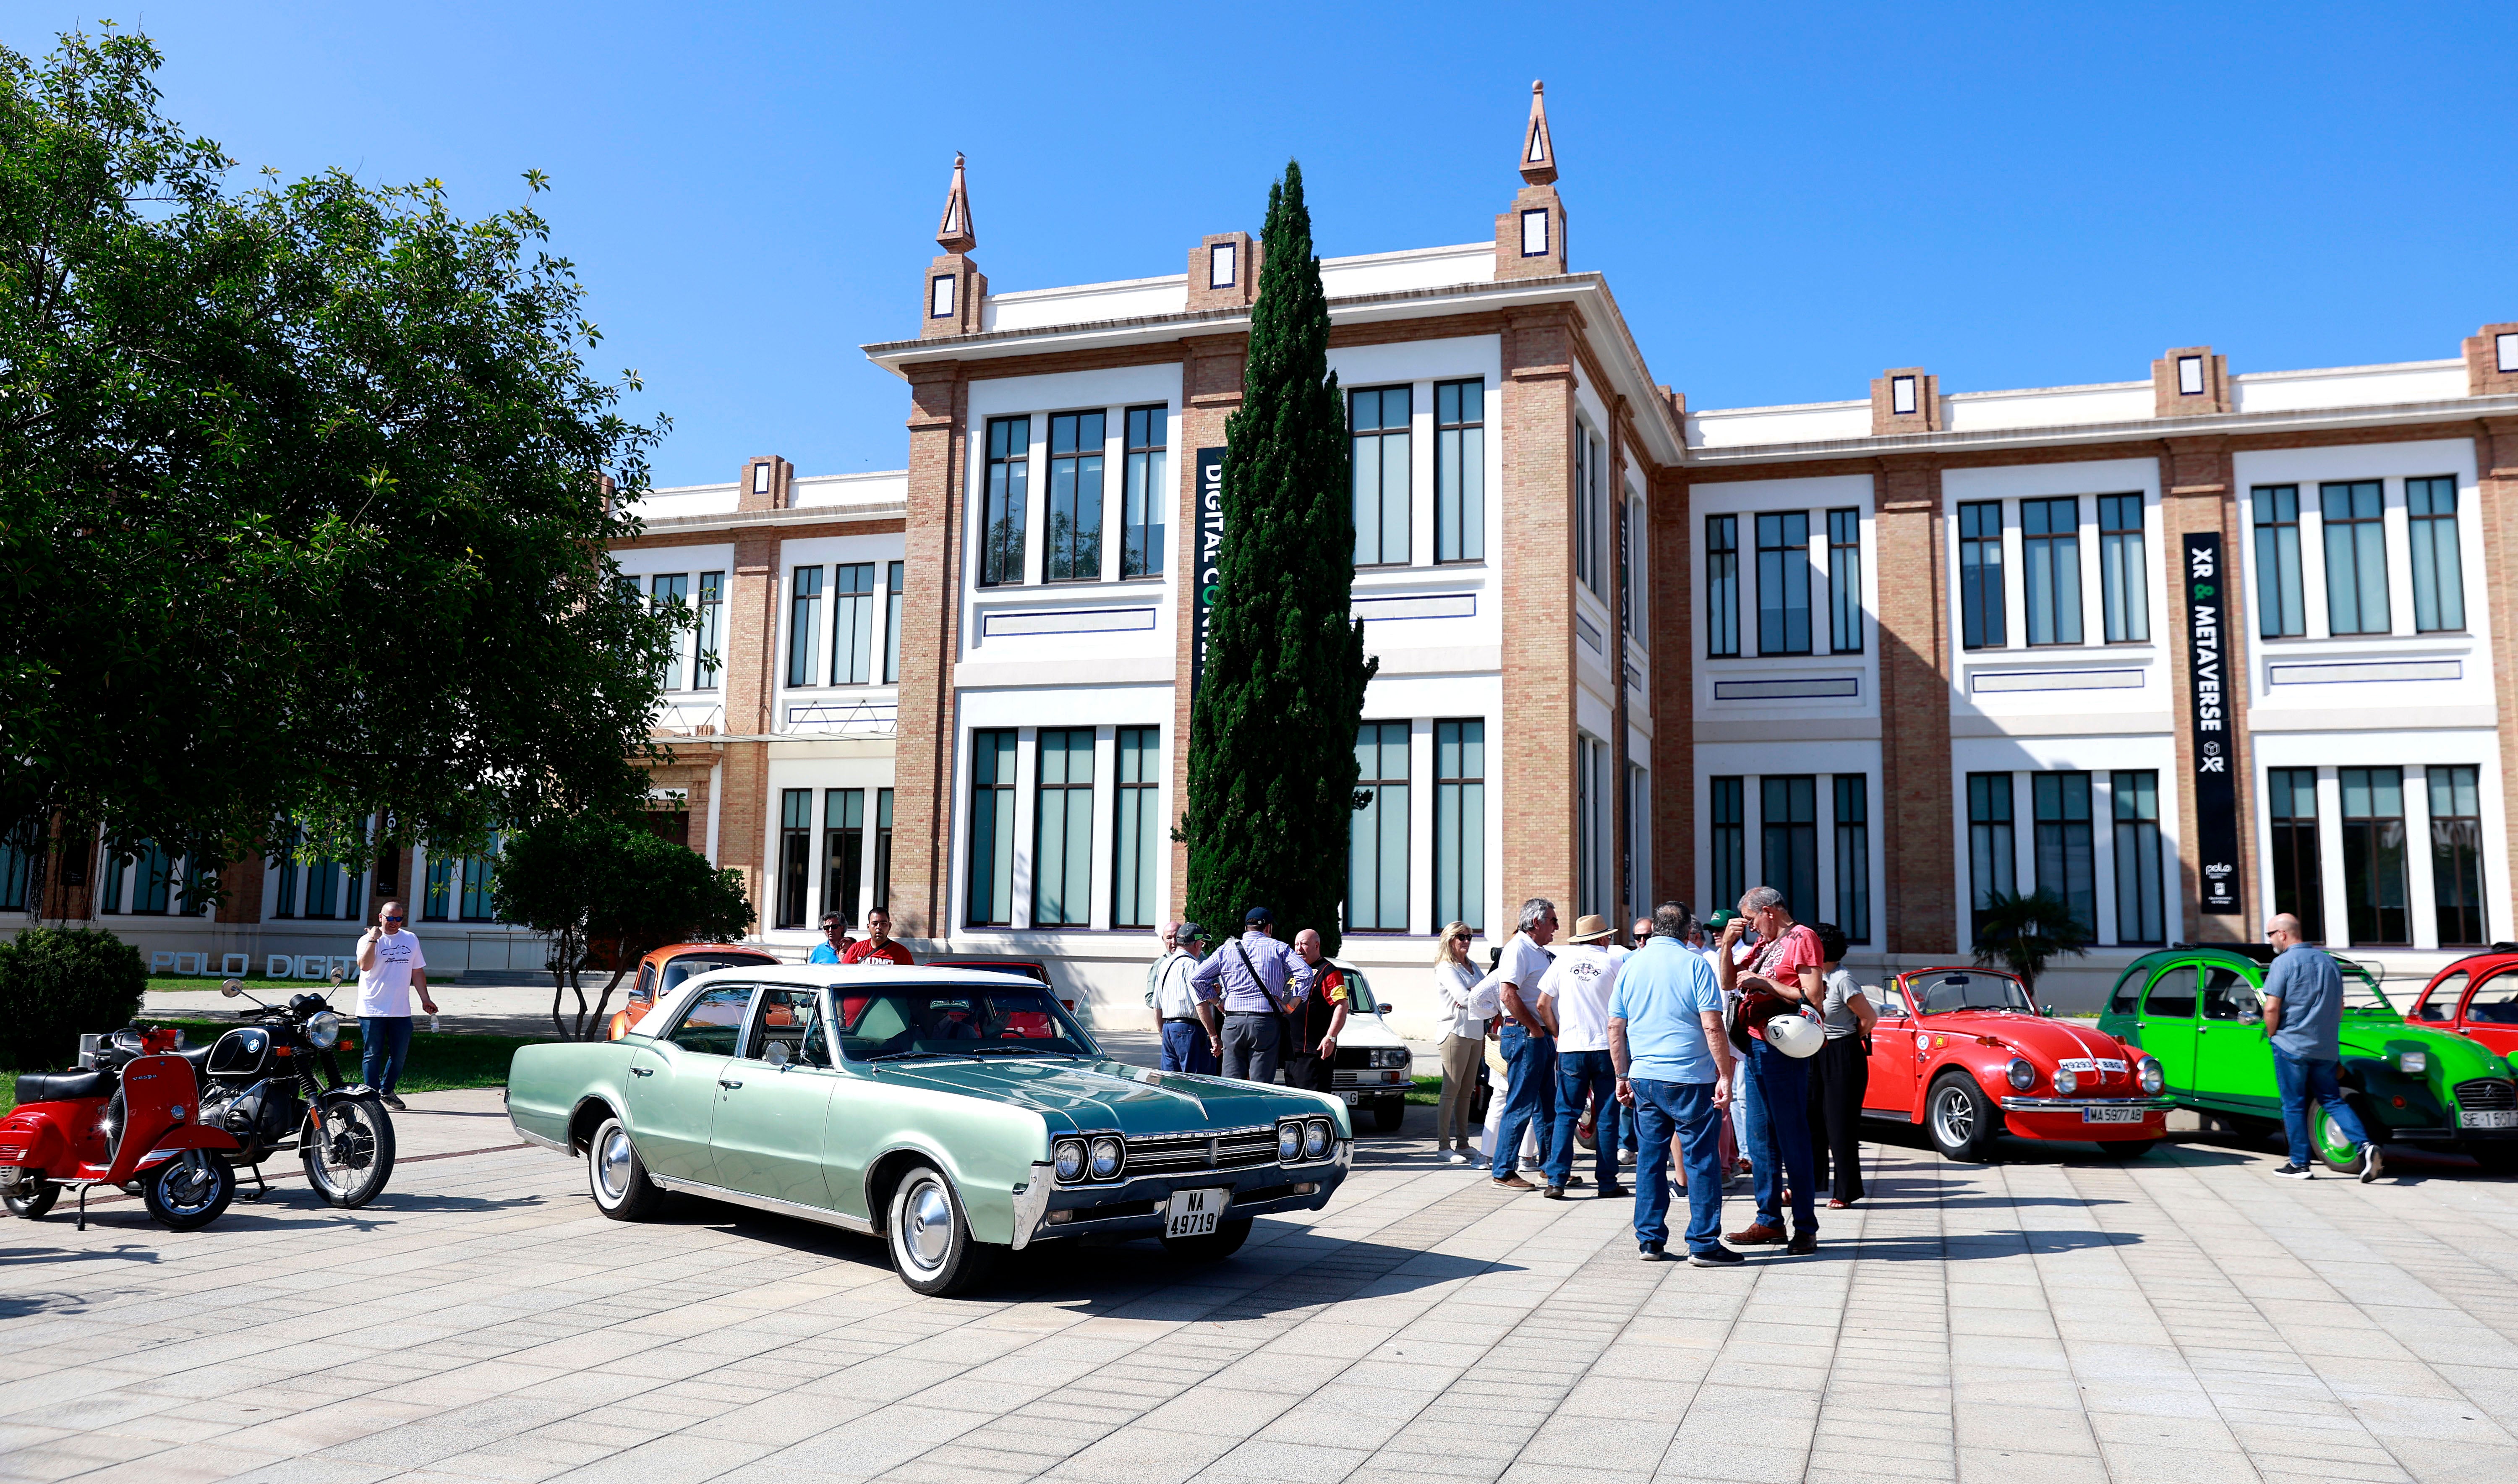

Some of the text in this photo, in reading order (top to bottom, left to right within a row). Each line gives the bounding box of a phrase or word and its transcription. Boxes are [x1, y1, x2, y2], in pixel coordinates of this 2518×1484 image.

[1204, 464, 1224, 562] DIGITAL
[2191, 547, 2222, 731] XR & METAVERSE
[2199, 756, 2225, 772] XR
[2205, 862, 2233, 876] polo
[150, 951, 250, 978] POLO
[2105, 1109, 2129, 1121] 5977
[1148, 1127, 1262, 1140] OLDSMOBILE
[1187, 1192, 1204, 1212] NA
[1170, 1213, 1215, 1235] 49719
